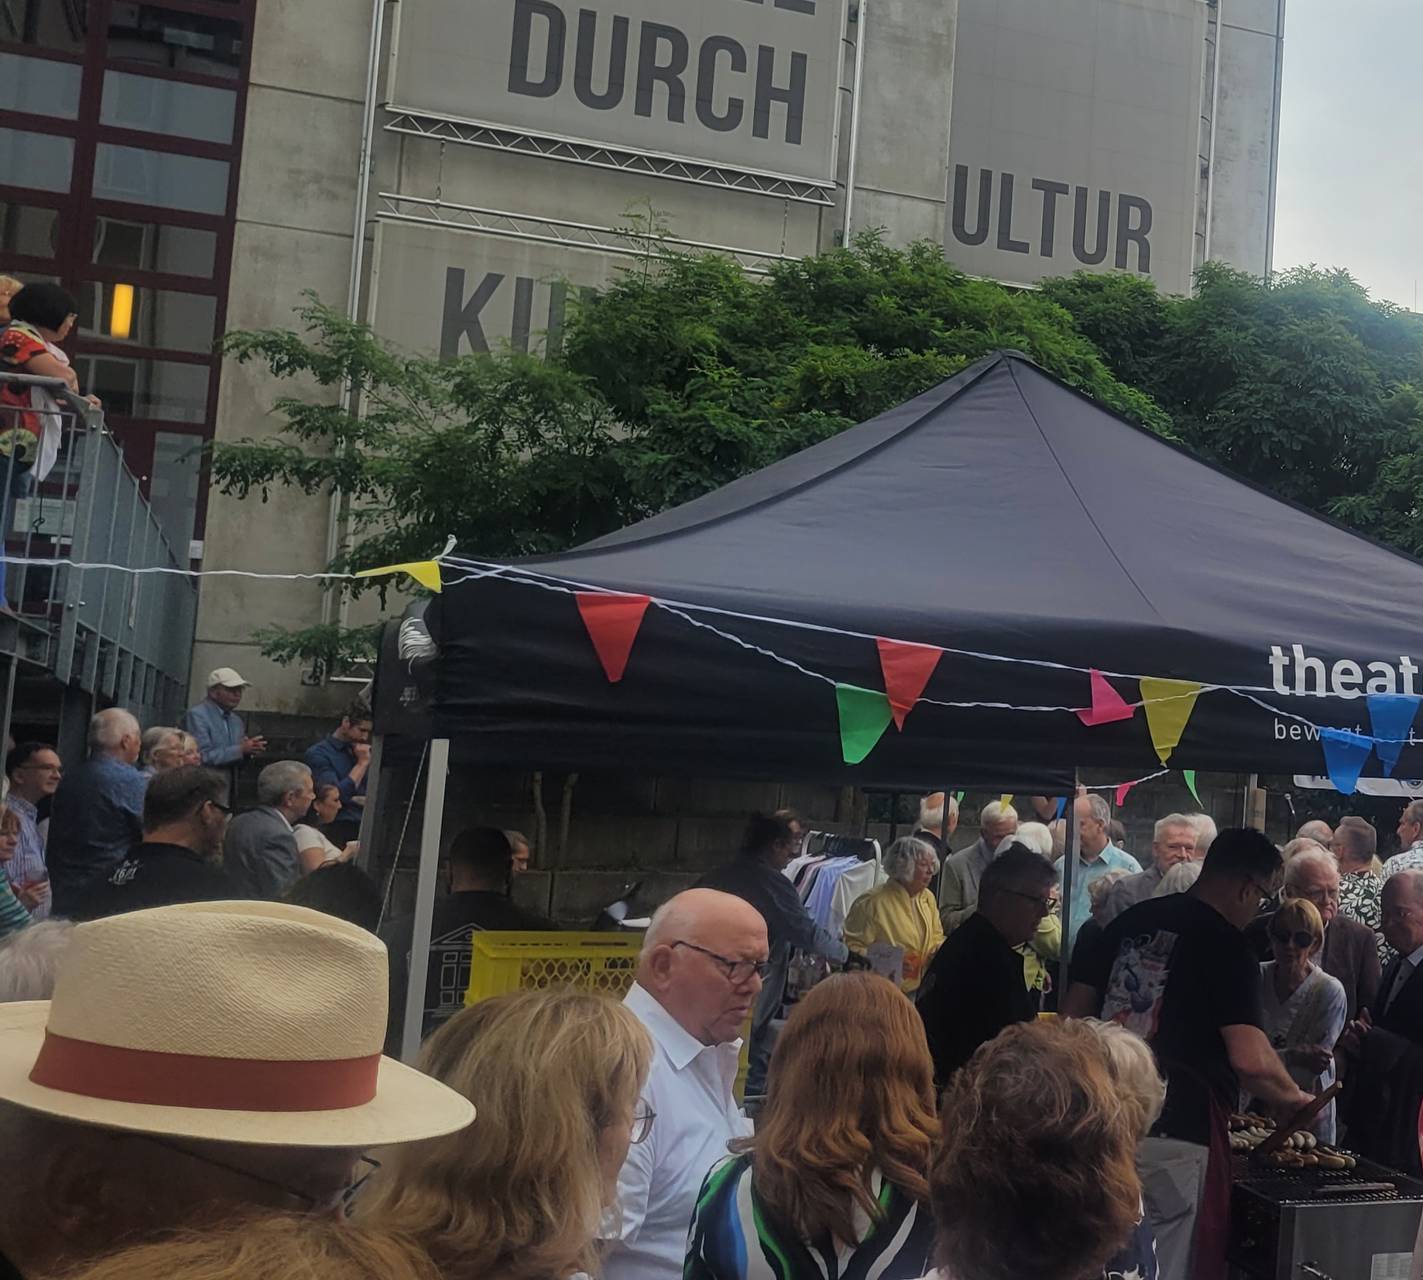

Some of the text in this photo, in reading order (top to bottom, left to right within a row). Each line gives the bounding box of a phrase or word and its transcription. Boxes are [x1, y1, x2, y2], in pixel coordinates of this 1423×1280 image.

[507, 0, 808, 146] DURCH
[951, 163, 1153, 274] ULTUR
[1273, 717, 1364, 744] bewt
